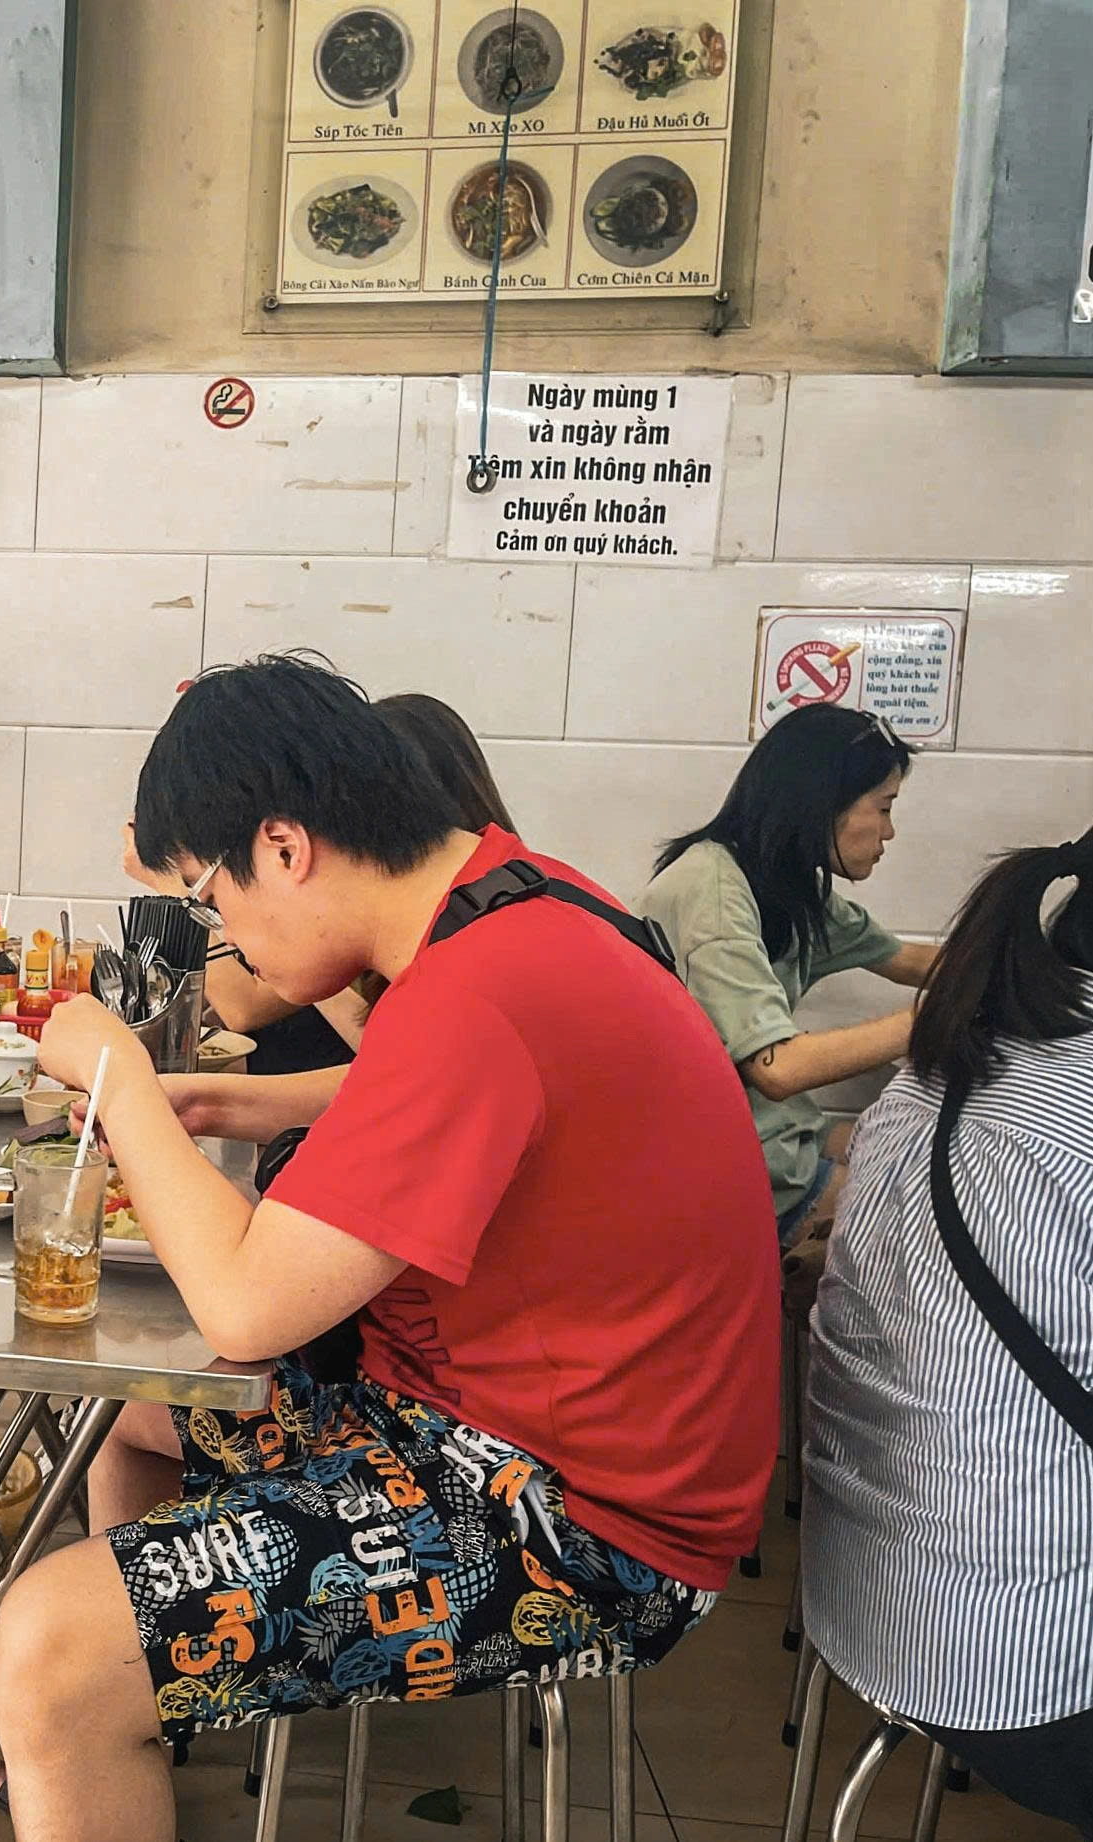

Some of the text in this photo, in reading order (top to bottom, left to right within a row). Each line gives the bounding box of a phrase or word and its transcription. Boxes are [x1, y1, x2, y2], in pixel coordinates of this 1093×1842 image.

[314, 123, 403, 141] Súp Tóc Tiên
[490, 120, 518, 133] Xo
[522, 119, 545, 132] XO
[597, 117, 625, 133] Đậu
[443, 274, 546, 288] Bánh Cnh Cua
[577, 273, 608, 285] Cơm
[612, 271, 651, 285] Chiên
[655, 270, 673, 284] Cá
[527, 383, 677, 411] Ngày mùng 1
[528, 415, 670, 447] và ngày rằm
[530, 455, 566, 480] xin
[574, 456, 646, 484] không
[653, 458, 711, 488] nhận
[503, 492, 666, 524] chuyển khoản
[496, 529, 678, 556] Cảm ơn quý khách.
[924, 670, 940, 680] vui
[140, 1510, 270, 1598] SURF
